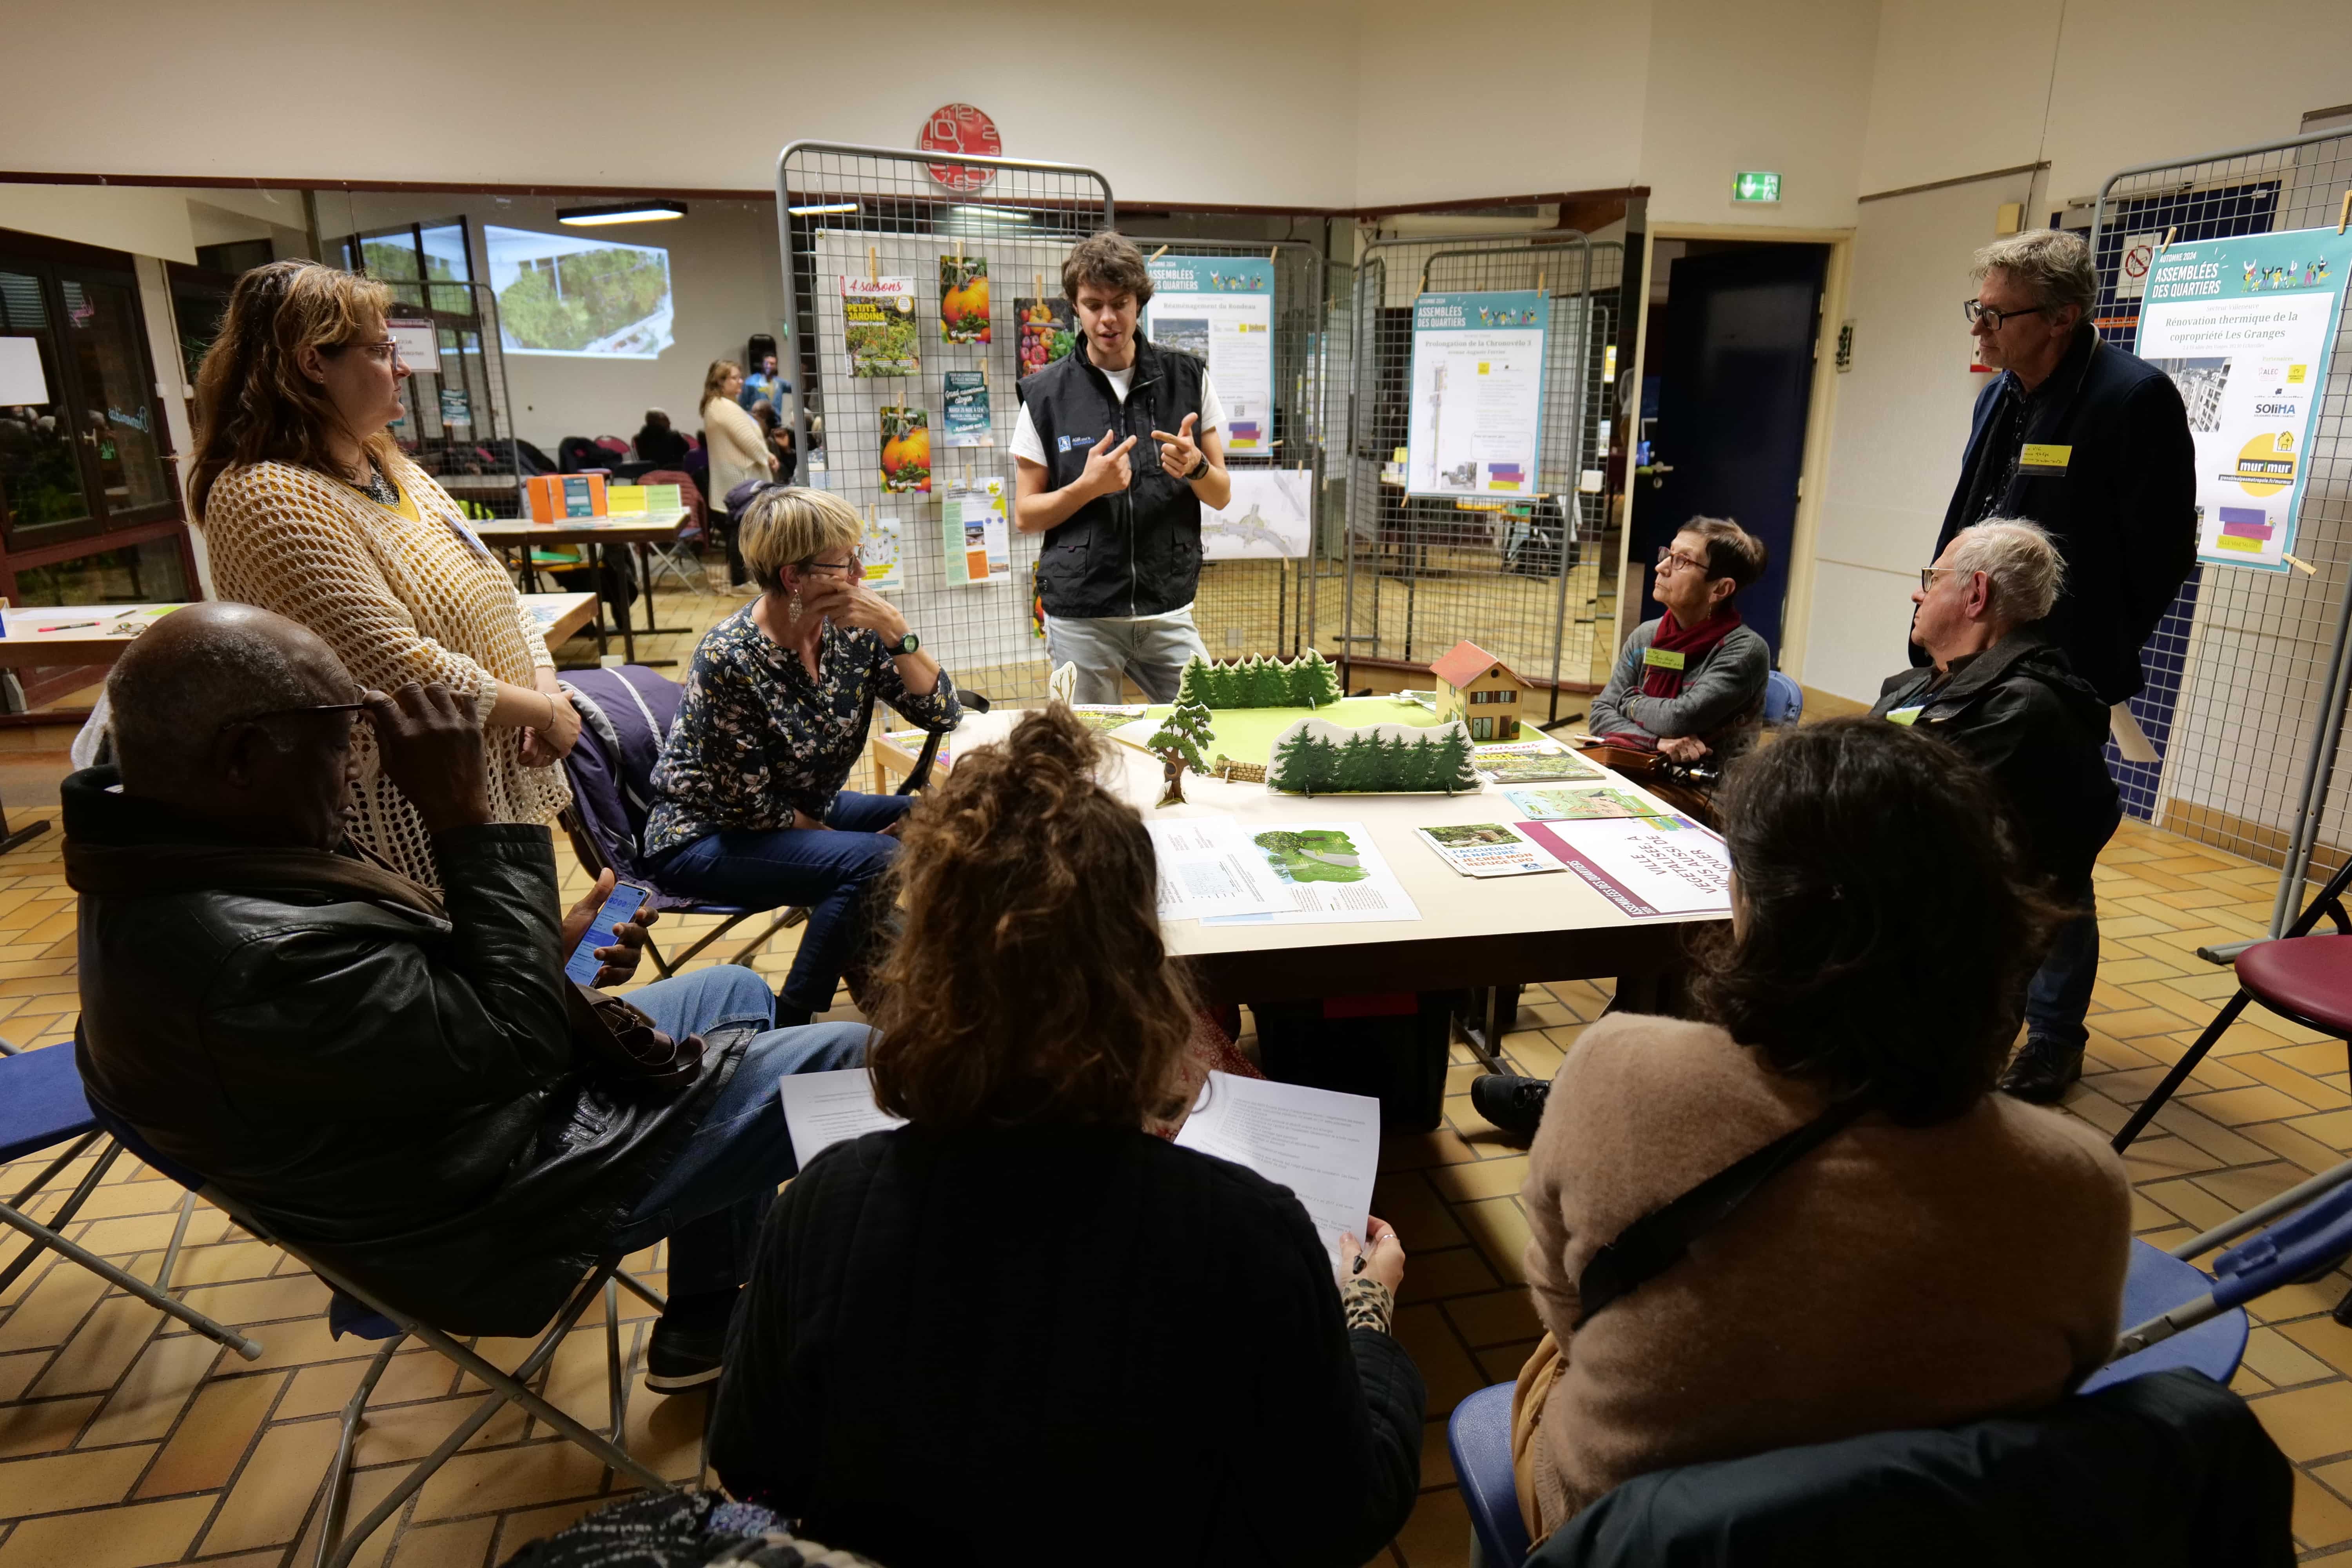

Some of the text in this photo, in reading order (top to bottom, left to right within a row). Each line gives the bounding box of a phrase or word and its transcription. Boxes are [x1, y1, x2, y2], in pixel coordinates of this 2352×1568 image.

[939, 110, 951, 119] 11
[950, 104, 974, 120] 12
[928, 118, 956, 141] 10
[982, 125, 997, 140] 2
[2159, 251, 2197, 263] AUTOMNE 2024
[941, 264, 985, 285] 2024
[1148, 268, 1194, 279] ASSEMBLÉES
[2155, 261, 2219, 283] ASSEMBLÉES
[849, 279, 858, 292] 4
[858, 281, 904, 292] saisons
[1163, 281, 1198, 290] QUARTIERS
[2152, 280, 2221, 298] DES QUARTIERS
[847, 303, 877, 312] PETITS
[1418, 305, 1462, 317] ASSEMBLÉES
[848, 312, 885, 321] JARDINS
[1417, 317, 1466, 327] DES QUARTIERS
[2165, 311, 2298, 327] Rénovation thermique de la
[2170, 329, 2286, 344] copropriété Les Granges
[881, 416, 925, 436] 2024
[1646, 835, 1669, 845] DE
[1451, 845, 1518, 854] J'ACCUEILLE
[1471, 849, 1521, 857] NATURE,
[1667, 846, 1704, 867] AUSSI
[1630, 854, 1667, 875] VILLE
[1638, 842, 1717, 894] VÉGÉTALISÉE,
[1567, 860, 1646, 915] ASSEMBLÉES DES QUARTIERS
